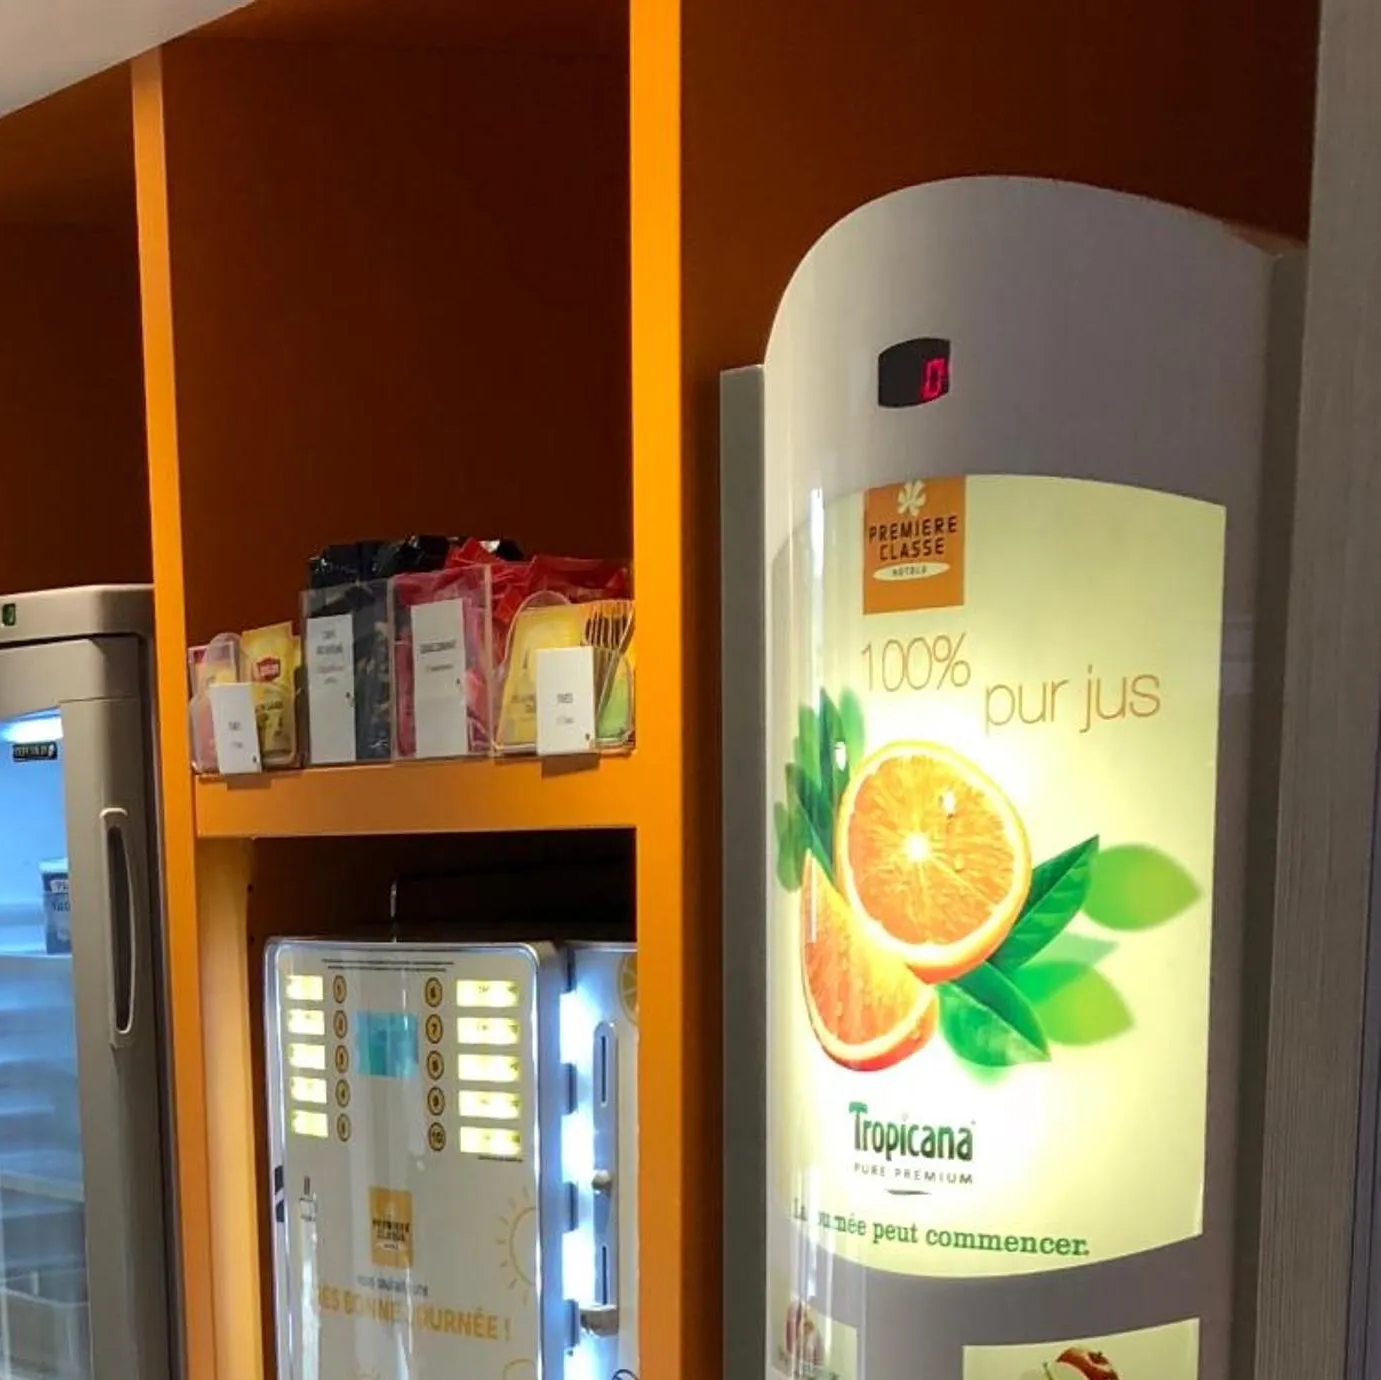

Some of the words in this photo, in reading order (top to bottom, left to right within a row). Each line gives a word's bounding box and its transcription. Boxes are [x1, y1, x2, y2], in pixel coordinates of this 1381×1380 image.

[868, 516, 958, 542] PREMIERE
[879, 537, 945, 561] CLASSE
[861, 631, 972, 693] 100%
[985, 679, 1069, 736] pur
[1080, 664, 1161, 733] jus
[848, 1101, 974, 1162] Tropicana
[854, 1162, 886, 1178] PURE
[894, 1167, 974, 1185] PREMIUM
[872, 1220, 919, 1244] peut
[925, 1228, 1091, 1257] commencer.
